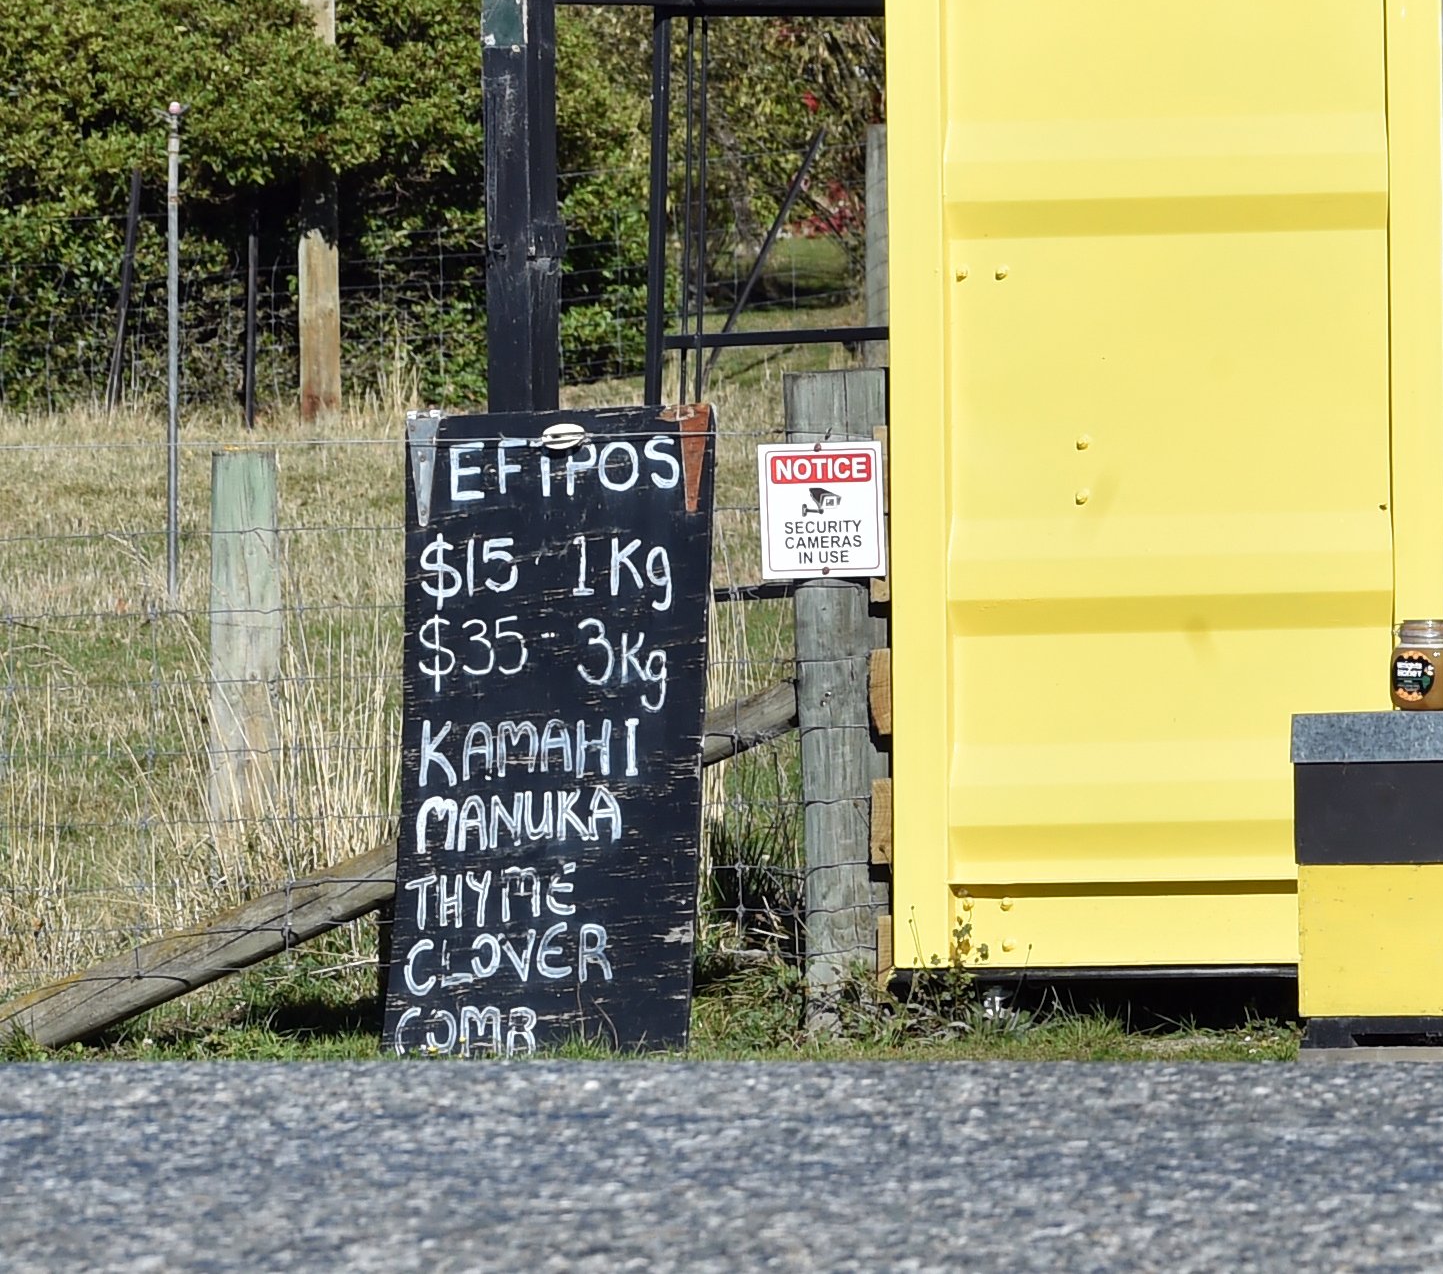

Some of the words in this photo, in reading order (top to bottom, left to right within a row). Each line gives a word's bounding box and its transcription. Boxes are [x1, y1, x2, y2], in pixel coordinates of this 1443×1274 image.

[449, 435, 680, 501] EFTPOS
[775, 457, 868, 480] NOTICE
[784, 519, 862, 535] SECURITY
[784, 534, 862, 549] CAMERAS
[798, 551, 813, 564] IN
[818, 550, 850, 564] USE
[419, 533, 519, 610] $15
[418, 614, 528, 693] $35
[418, 718, 639, 786] KAMAHI
[415, 786, 622, 853] MANUKA
[406, 862, 576, 929] THYME
[404, 923, 613, 995] CLOVER
